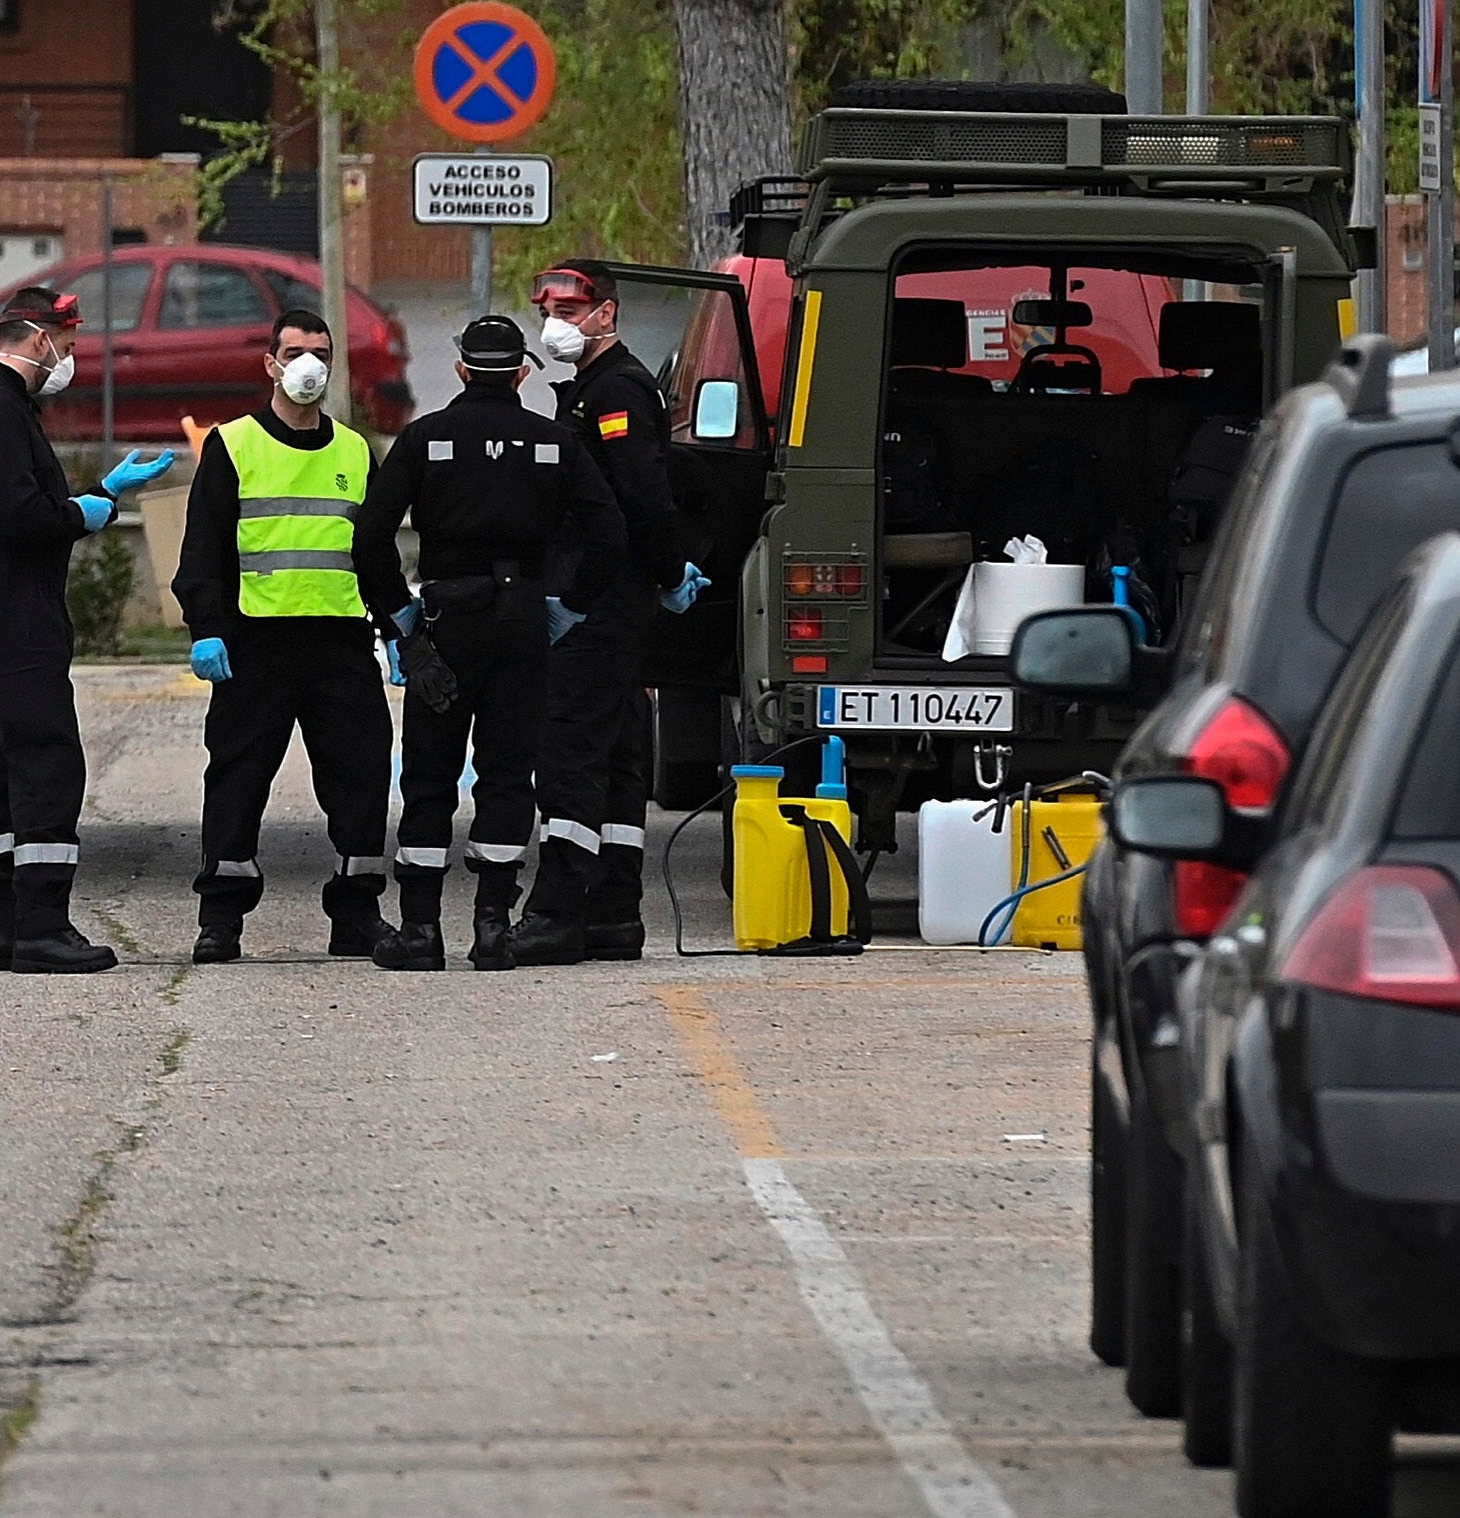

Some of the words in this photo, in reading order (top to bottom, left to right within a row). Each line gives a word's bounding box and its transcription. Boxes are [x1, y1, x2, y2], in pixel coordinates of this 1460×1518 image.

[445, 165, 520, 179] ACCESO
[429, 182, 535, 198] VEHÍCULOS
[429, 201, 534, 215] BOMBEROS
[966, 309, 1006, 317] GENCIAS
[840, 691, 880, 723] ET
[890, 693, 1003, 725] 110447
